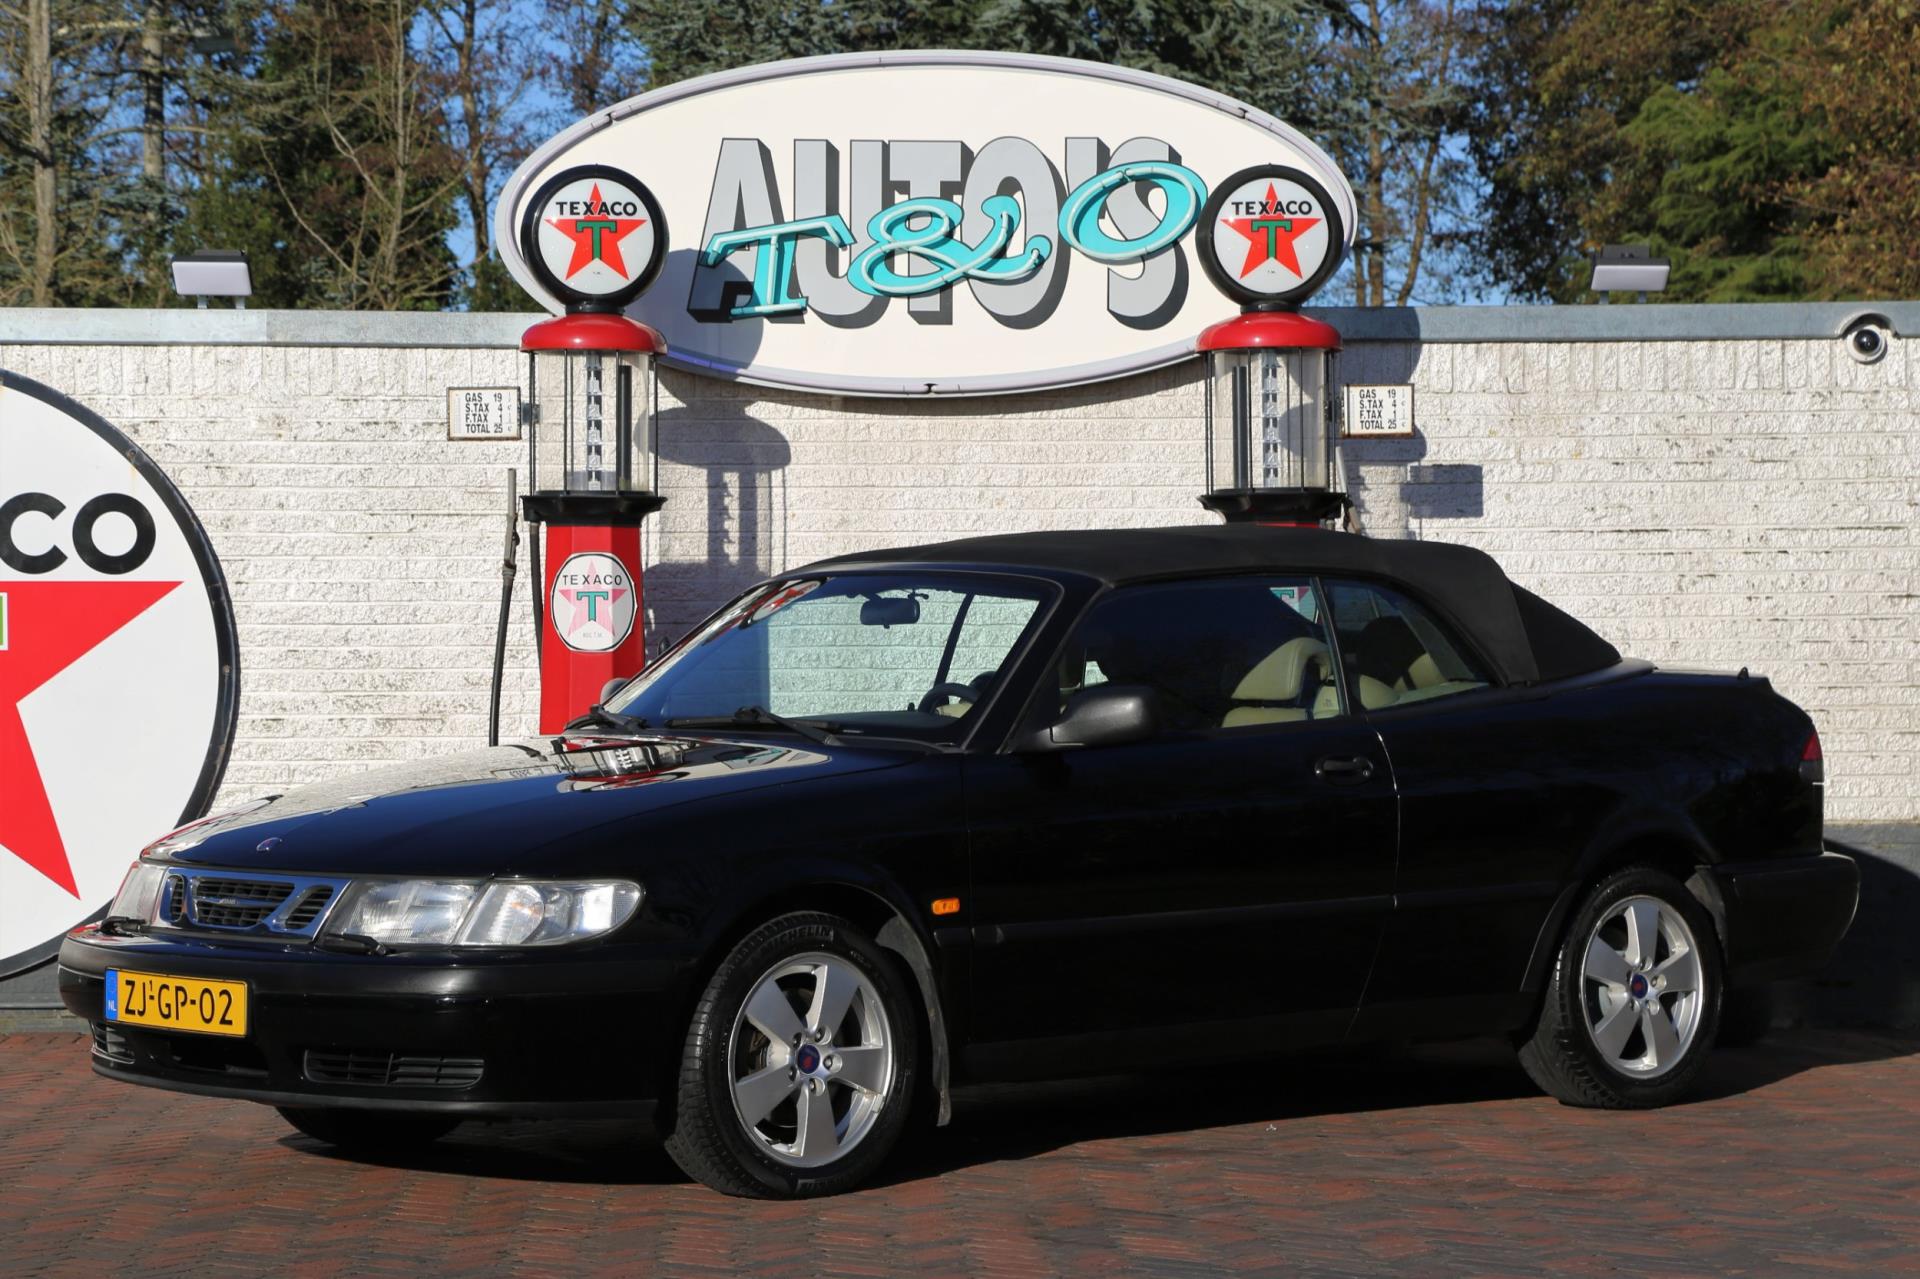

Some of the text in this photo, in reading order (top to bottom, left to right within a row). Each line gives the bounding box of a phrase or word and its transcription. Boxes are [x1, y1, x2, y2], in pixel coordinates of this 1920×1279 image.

[555, 201, 638, 216] TEXACO
[1231, 200, 1313, 216] TEXACO
[687, 136, 1189, 330] AUTO'S
[575, 220, 617, 261] T
[1250, 219, 1293, 260] T
[465, 392, 503, 402] GAS 19
[1359, 389, 1397, 399] GAS 19
[465, 403, 490, 413] S.TAX
[1359, 399, 1384, 409] S.TAX
[465, 413, 488, 423] F.TAX
[1359, 410, 1383, 419] F.TAX
[465, 424, 490, 433] TOTAL
[493, 424, 503, 434] 25
[1360, 420, 1384, 430] TOTAL
[1387, 420, 1397, 430] 25
[562, 574, 623, 586] TEXACO
[576, 591, 609, 622] T
[107, 979, 234, 1026] NL ZJ-GP-02
